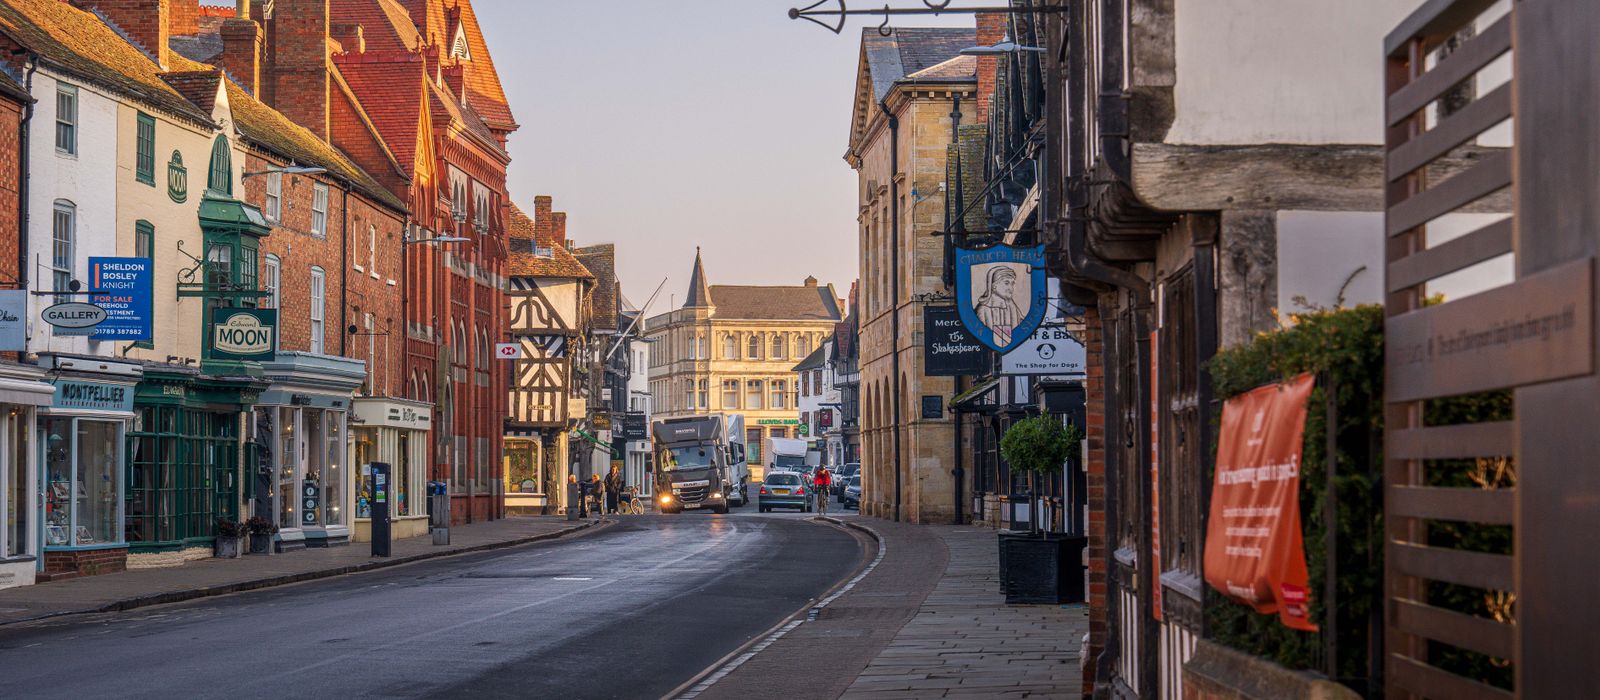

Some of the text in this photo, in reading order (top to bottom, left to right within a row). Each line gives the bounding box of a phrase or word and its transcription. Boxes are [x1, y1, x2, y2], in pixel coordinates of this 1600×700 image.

[960, 251, 1007, 264] CHAUCER
[103, 263, 145, 271] SHELDON
[48, 311, 100, 320] GALLERY
[230, 320, 257, 328] Edward
[935, 319, 961, 327] Merc
[219, 328, 268, 346] MOON
[949, 330, 964, 343] The
[1041, 330, 1050, 340] &
[931, 342, 981, 355] Shakespeare
[1061, 362, 1079, 370] Dogs
[62, 383, 124, 402] MONTPELLIER
